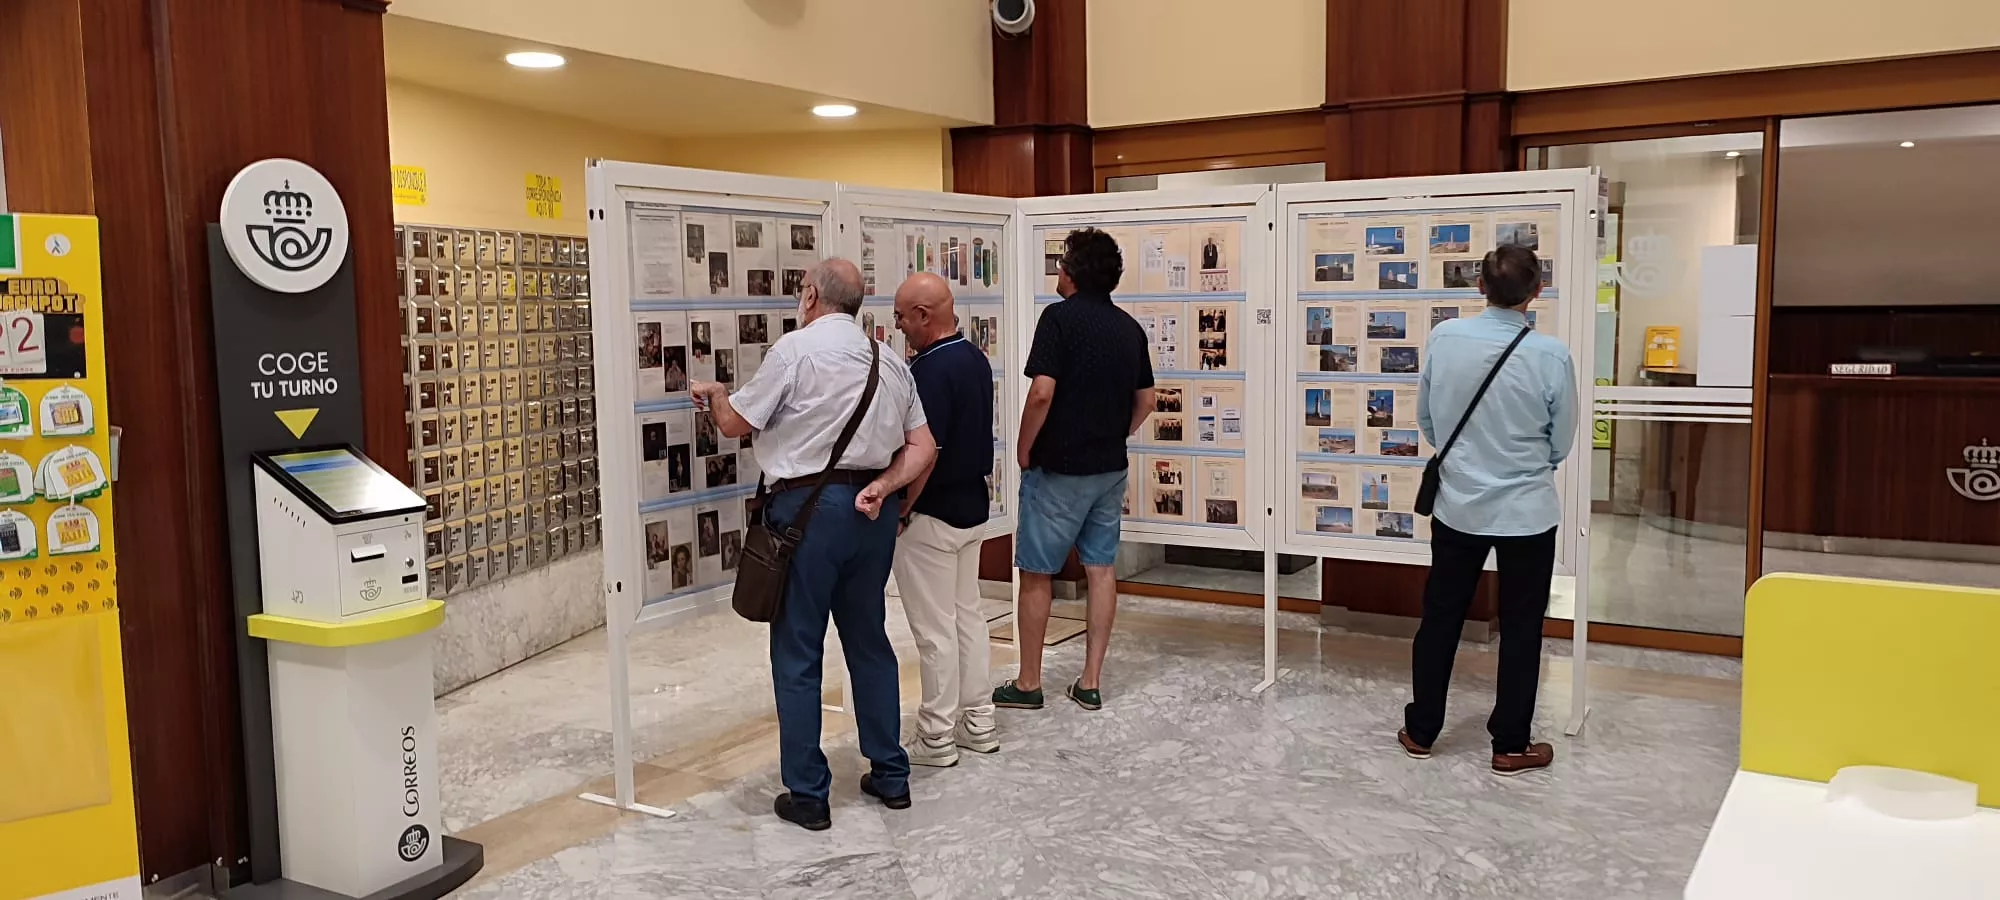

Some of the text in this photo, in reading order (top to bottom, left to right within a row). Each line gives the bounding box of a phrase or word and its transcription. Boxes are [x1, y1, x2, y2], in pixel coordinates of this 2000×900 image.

[8, 279, 57, 296] EURO
[258, 352, 329, 375] COGE
[250, 377, 338, 399] TU TURNO
[400, 725, 420, 818] CORREOS
